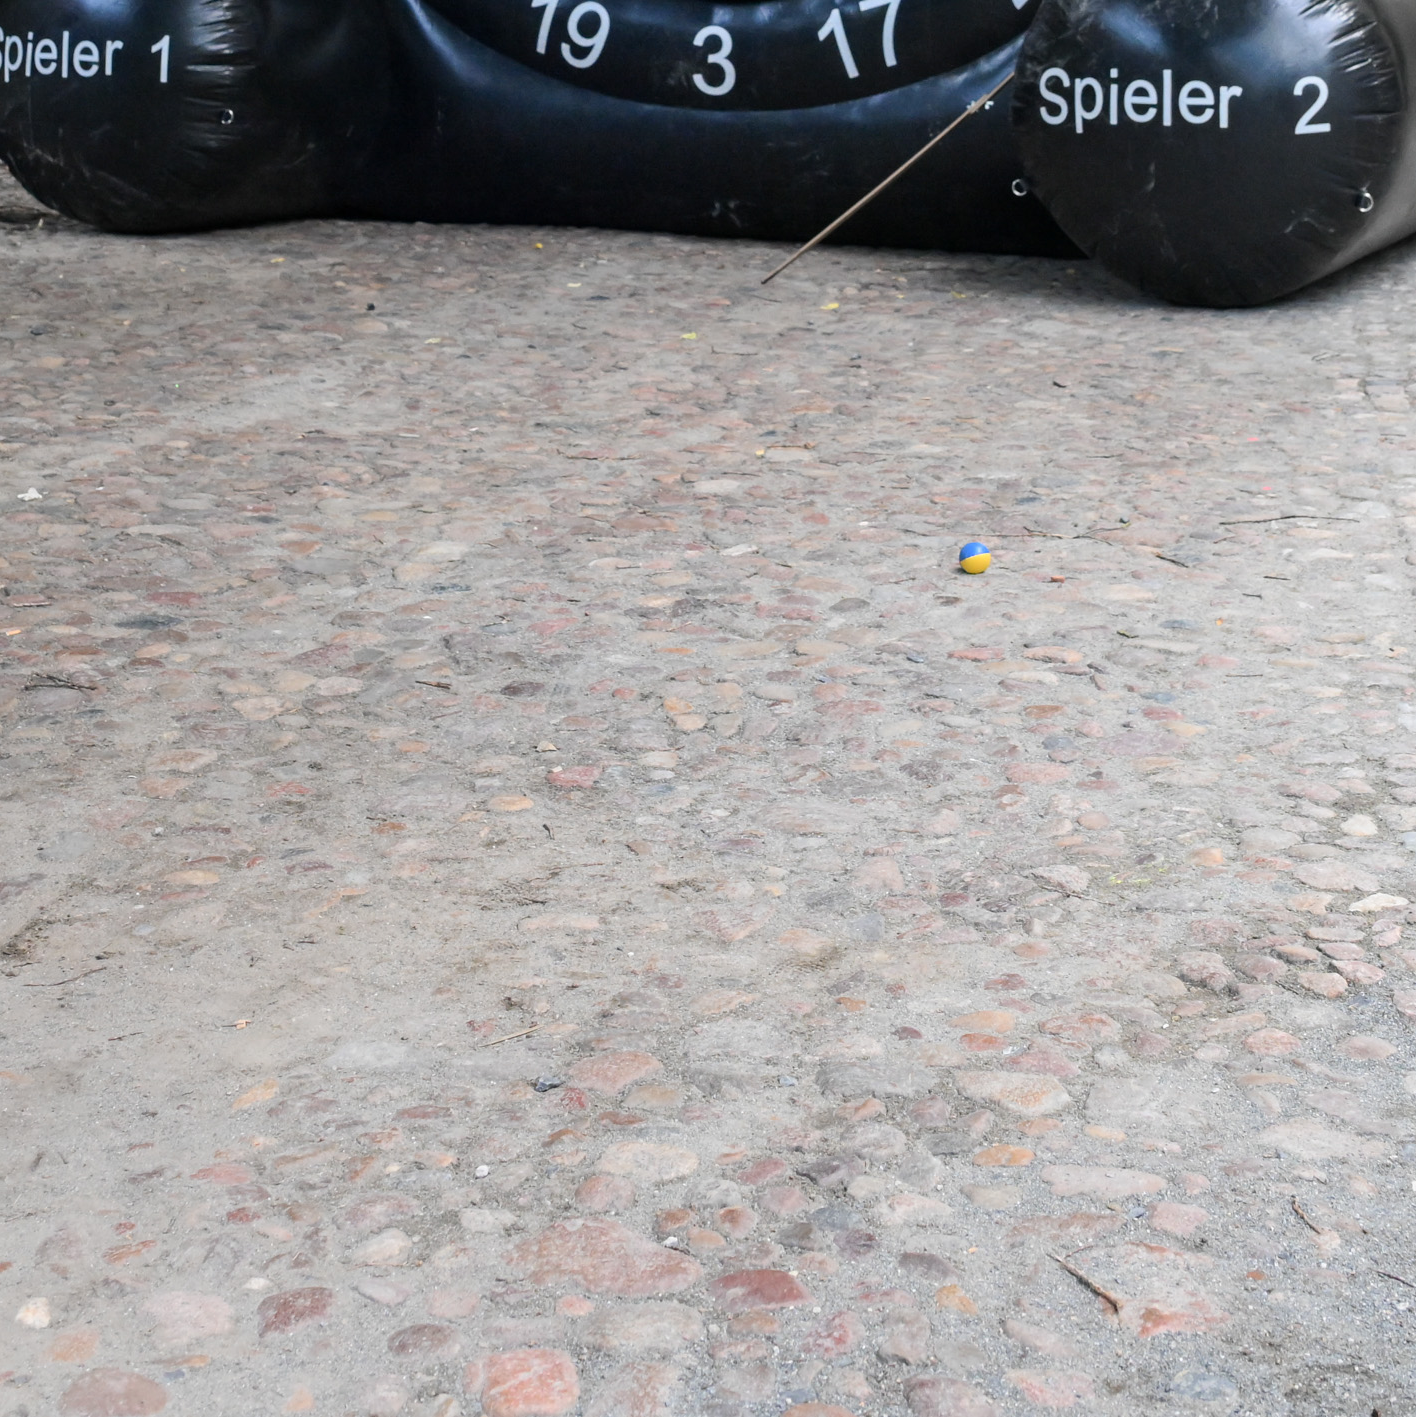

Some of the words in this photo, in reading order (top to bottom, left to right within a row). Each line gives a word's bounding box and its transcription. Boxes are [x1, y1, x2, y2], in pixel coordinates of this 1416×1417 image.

[151, 35, 170, 83] 1
[693, 25, 735, 95] 3
[1040, 68, 1242, 133] Spieler
[1294, 76, 1330, 134] 2
